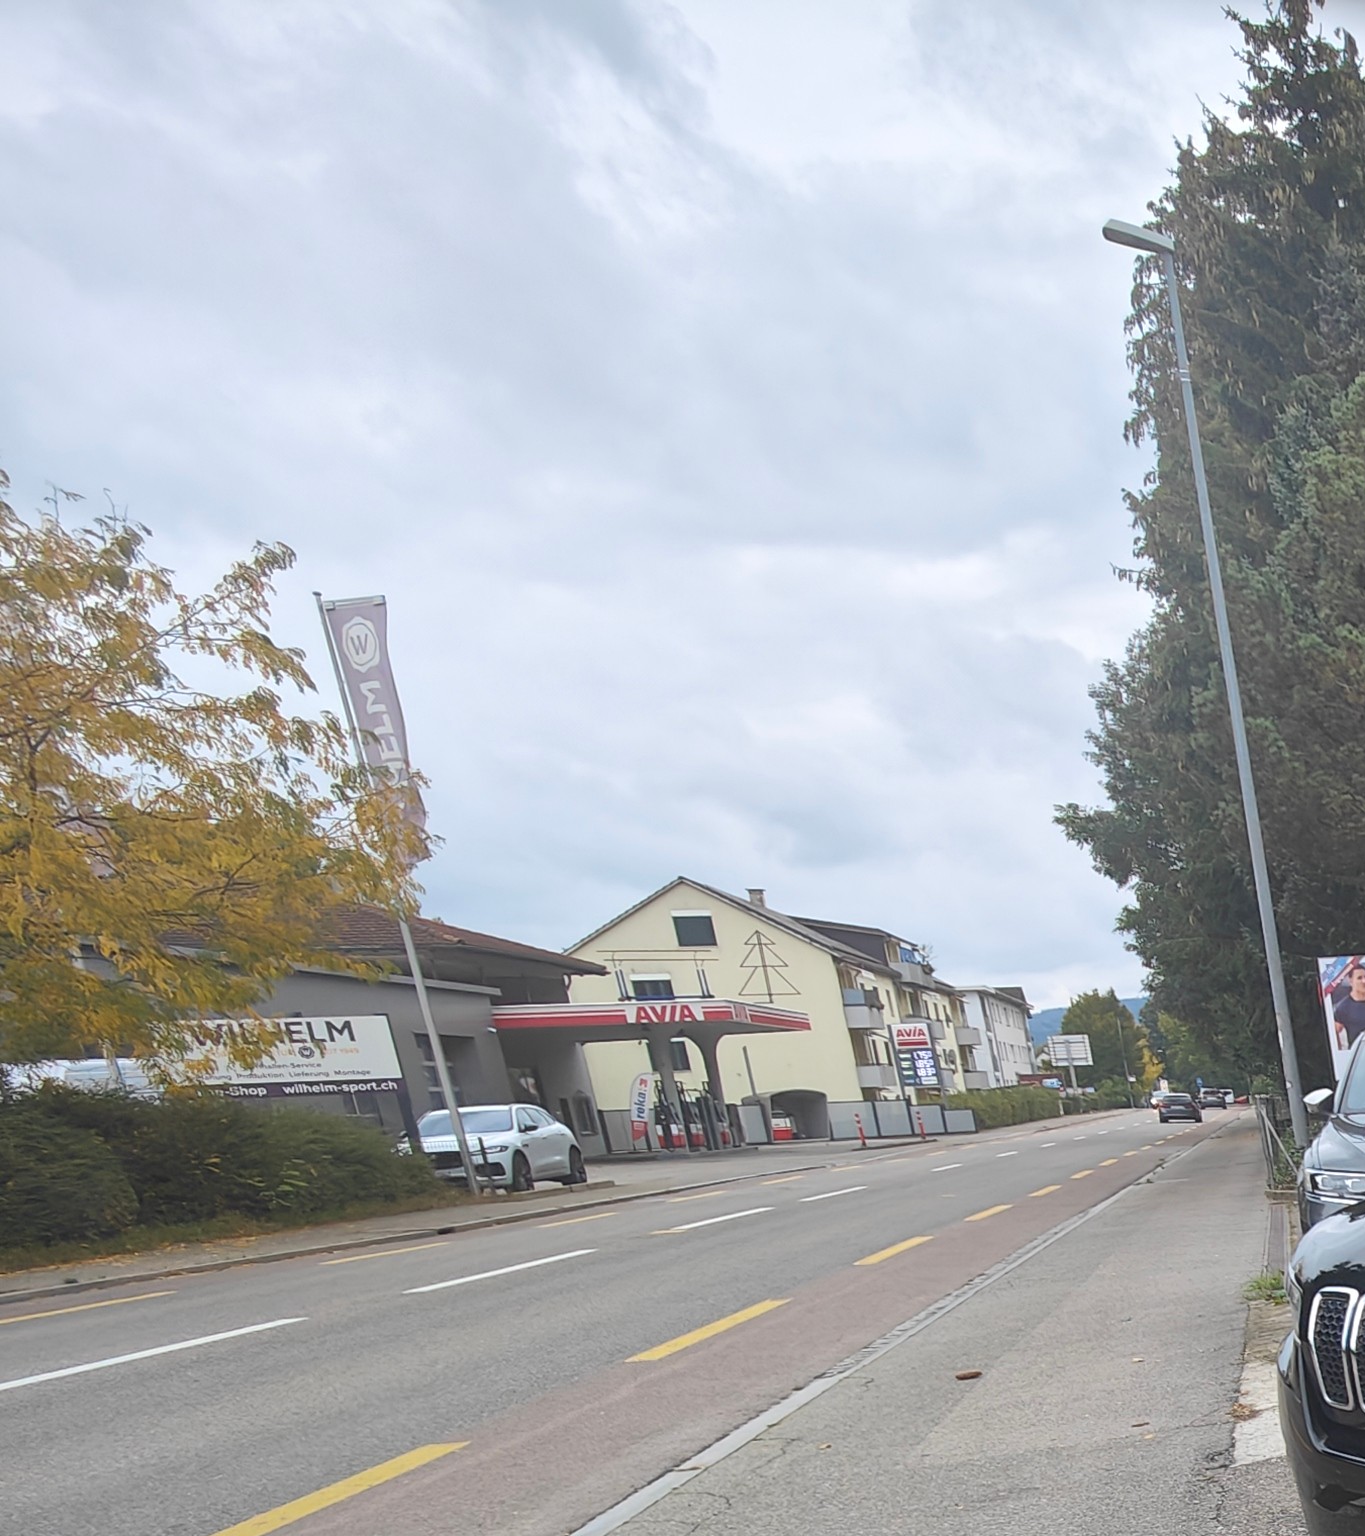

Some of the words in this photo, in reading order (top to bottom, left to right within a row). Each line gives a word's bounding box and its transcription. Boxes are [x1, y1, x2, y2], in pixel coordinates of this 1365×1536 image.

[635, 1004, 698, 1024] AVIA
[896, 1026, 926, 1038] AVIA
[333, 1069, 372, 1077] Montage
[282, 1080, 398, 1096] wilhelm-sport.ch
